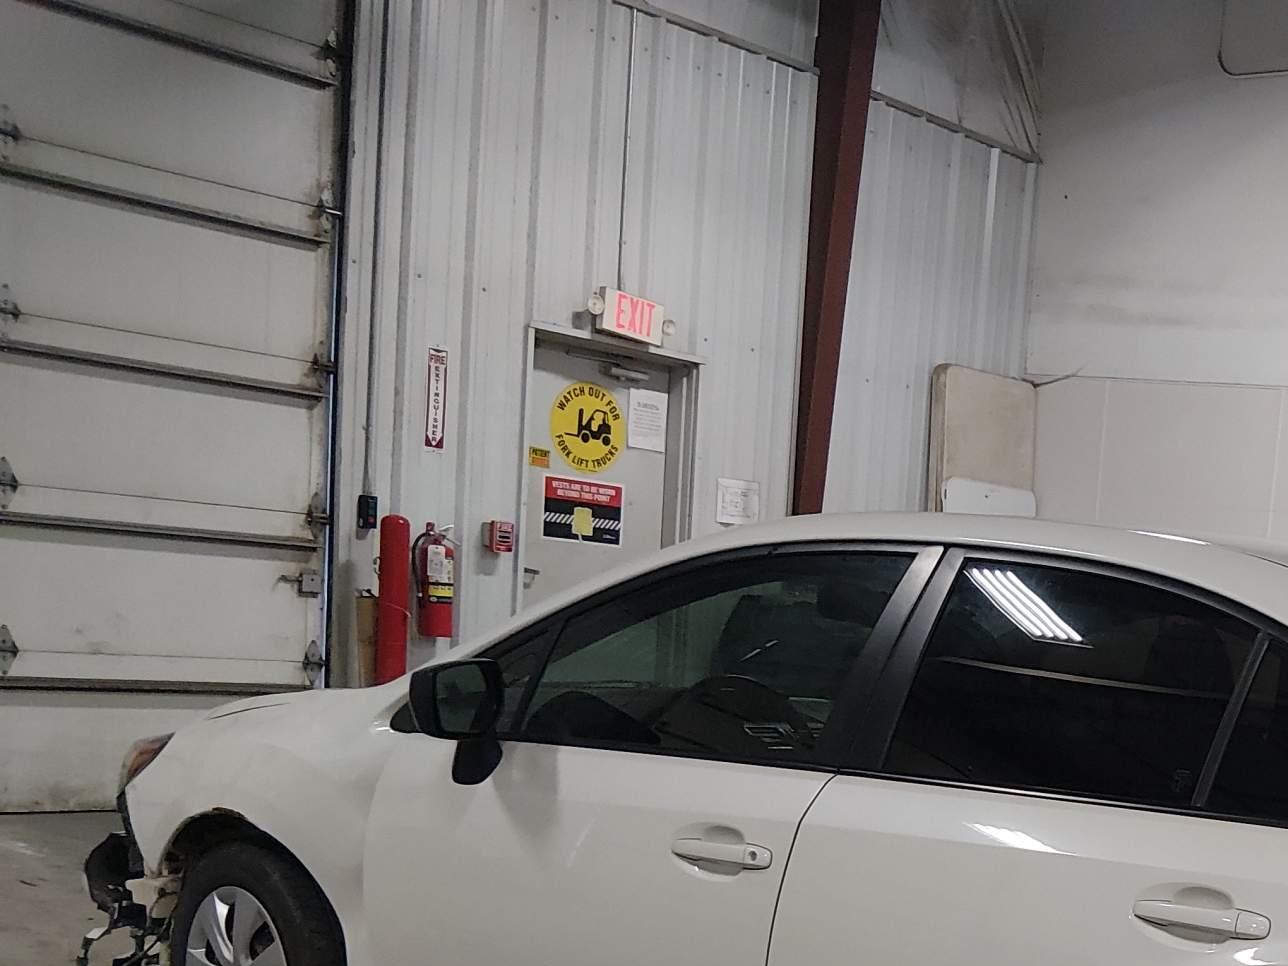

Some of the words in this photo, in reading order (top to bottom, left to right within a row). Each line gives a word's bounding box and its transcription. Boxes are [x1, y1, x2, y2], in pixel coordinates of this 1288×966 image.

[615, 292, 656, 337] EXIT
[429, 353, 446, 366] FIRE
[431, 366, 440, 442] EXTINGUISHER
[556, 386, 586, 411] WATCH
[588, 387, 606, 402] OUT
[605, 399, 620, 421] FOR
[555, 433, 573, 458] FORK
[571, 455, 589, 468] LIFT
[591, 444, 619, 469] TRUCKS
[551, 480, 570, 489] VESTS
[570, 483, 581, 491] ARE
[582, 484, 590, 492] TO
[556, 488, 580, 498] BEYOND
[581, 492, 593, 500] THIS
[593, 494, 611, 502] POINT
